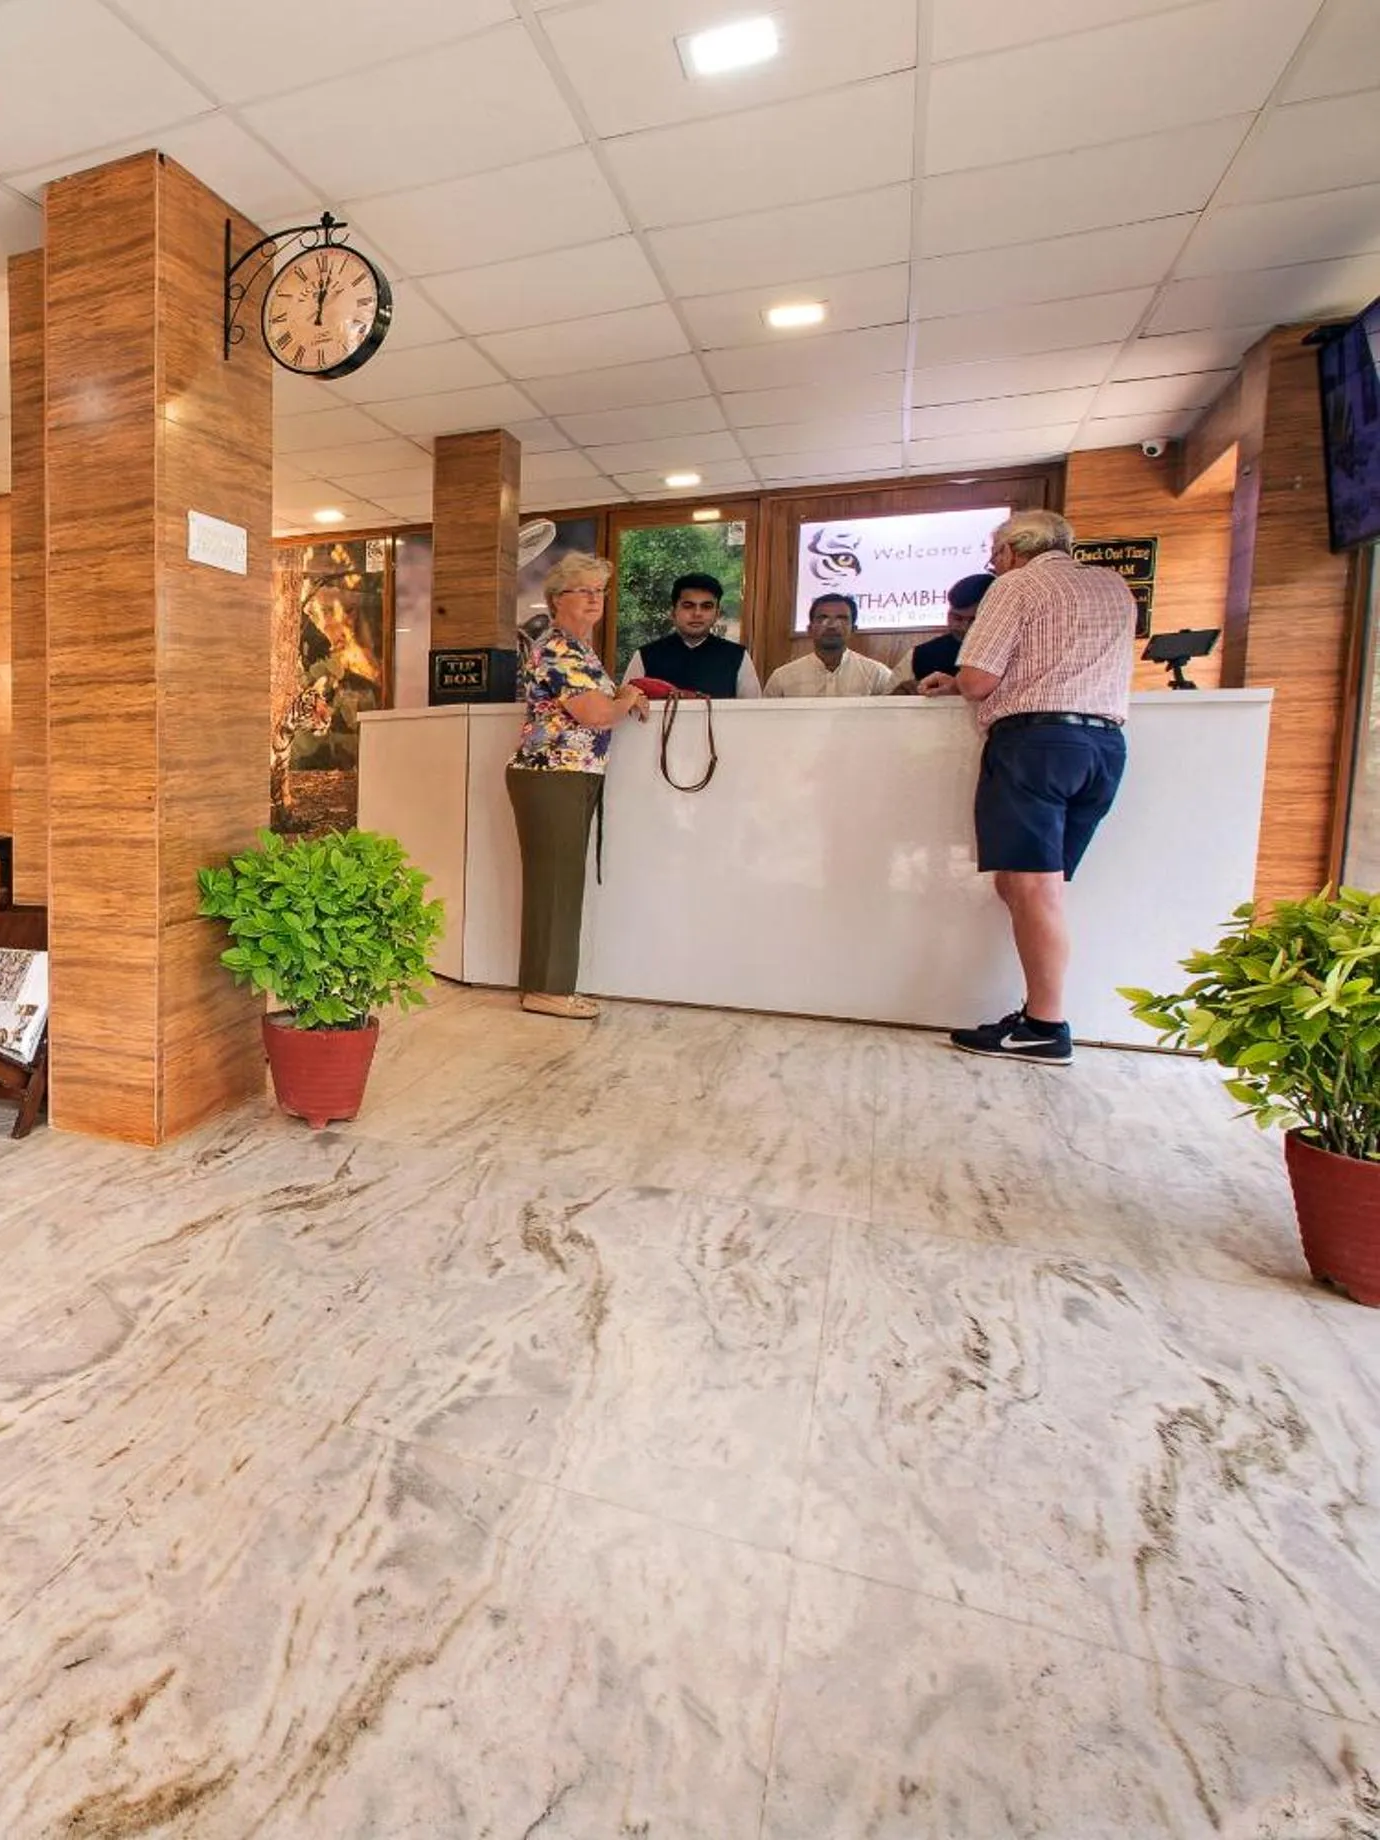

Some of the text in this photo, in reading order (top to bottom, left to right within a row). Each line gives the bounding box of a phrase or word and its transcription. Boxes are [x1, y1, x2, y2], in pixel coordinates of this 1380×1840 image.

[873, 543, 973, 561] Welcome
[1074, 548, 1104, 561] Check
[1105, 547, 1123, 560] Out
[856, 589, 947, 610] THAMBH
[446, 661, 476, 673] TIP
[443, 673, 478, 686] BOX
